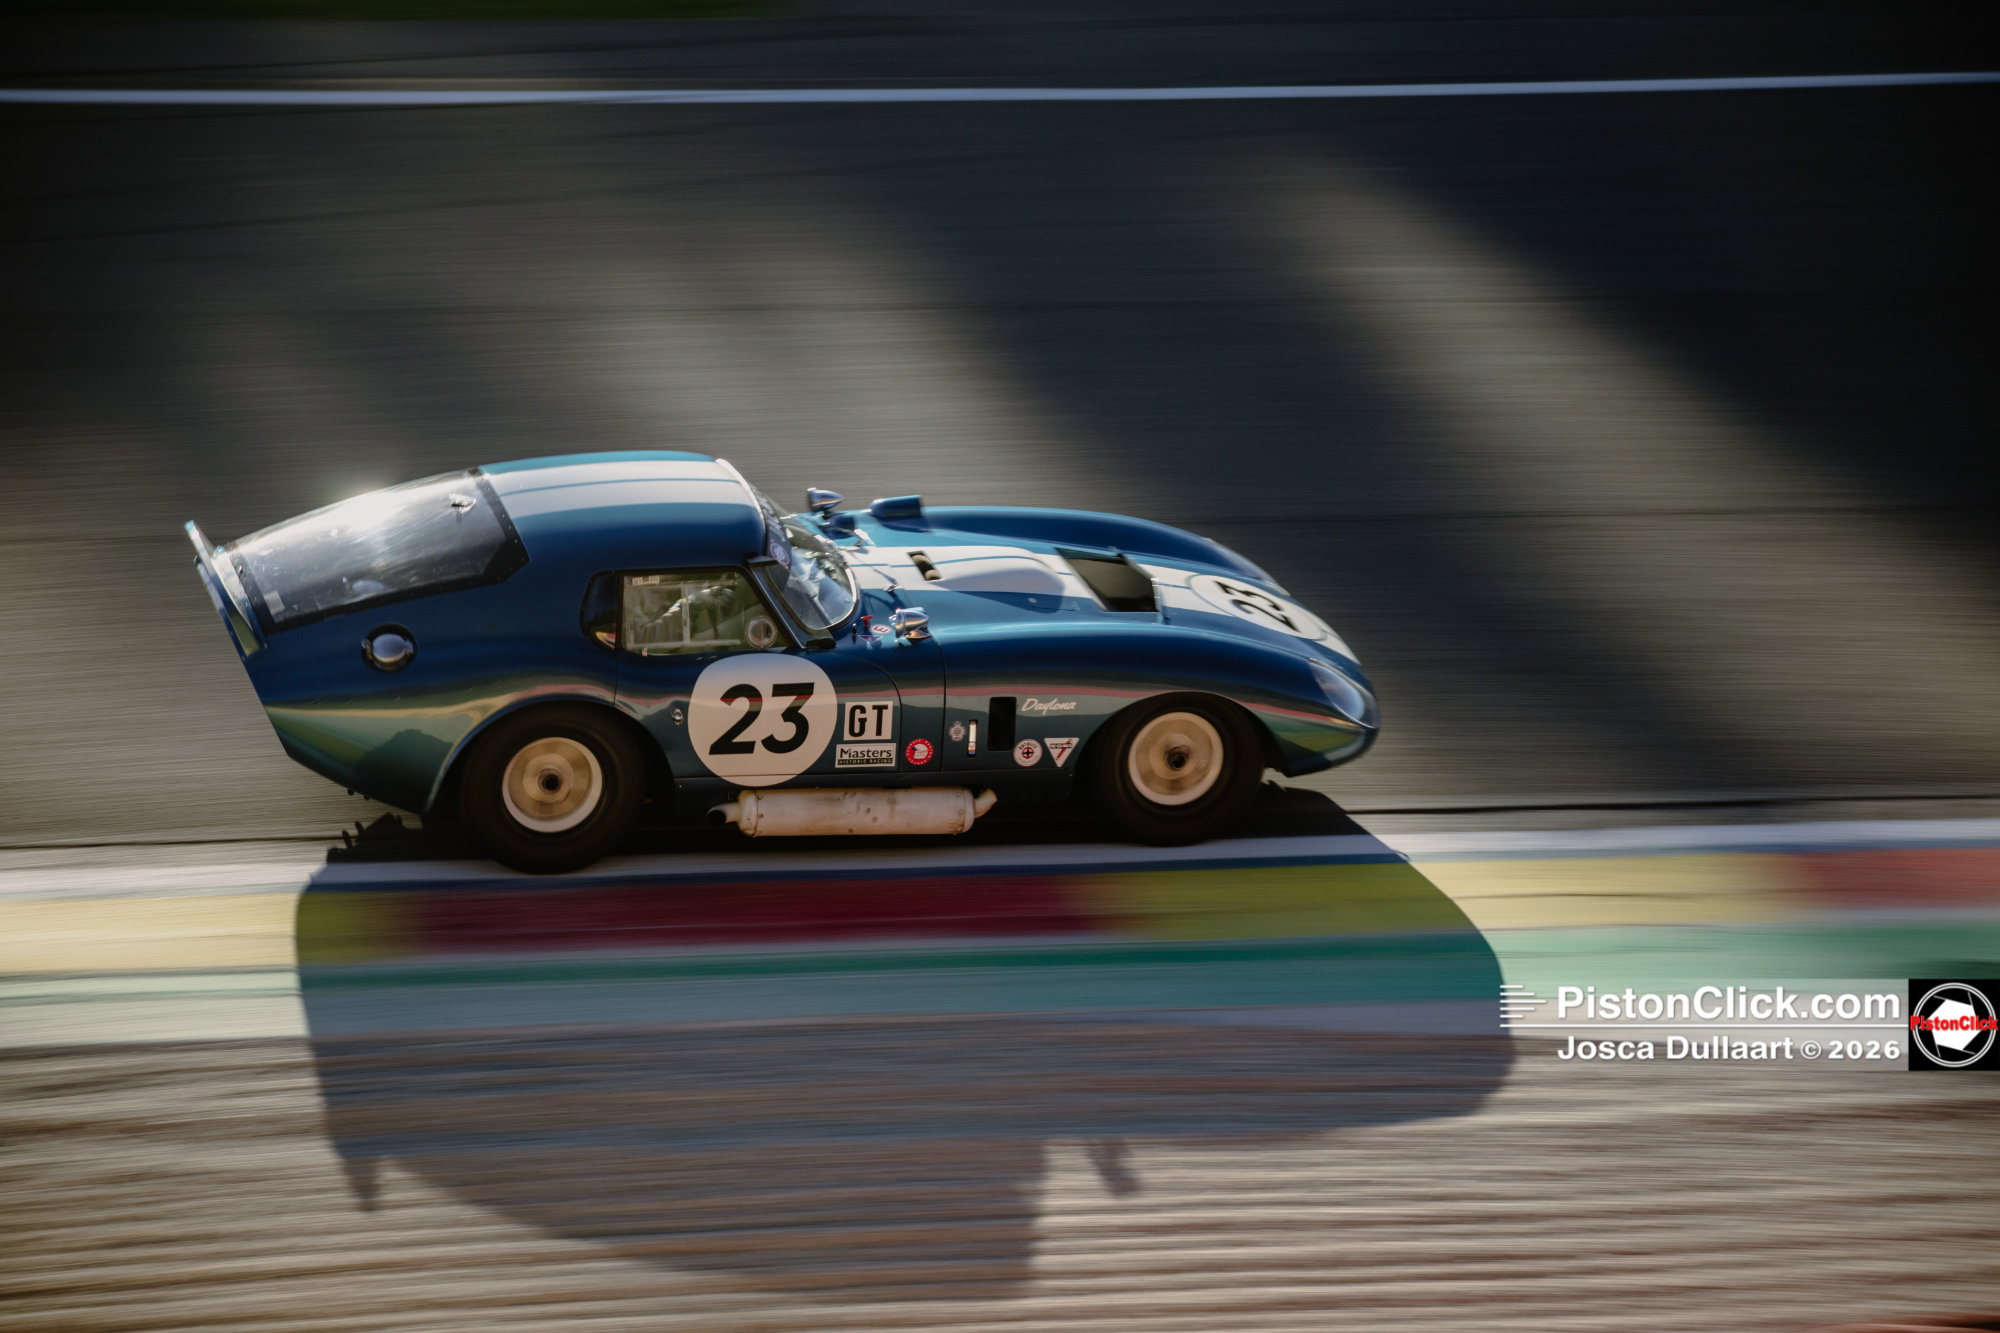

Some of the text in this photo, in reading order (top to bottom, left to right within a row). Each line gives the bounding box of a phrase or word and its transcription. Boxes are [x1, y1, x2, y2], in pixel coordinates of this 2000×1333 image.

[1213, 579, 1301, 633] 23
[708, 682, 815, 756] 23
[848, 704, 889, 737] GT
[1020, 698, 1078, 715] Daytona
[839, 747, 892, 759] Masters
